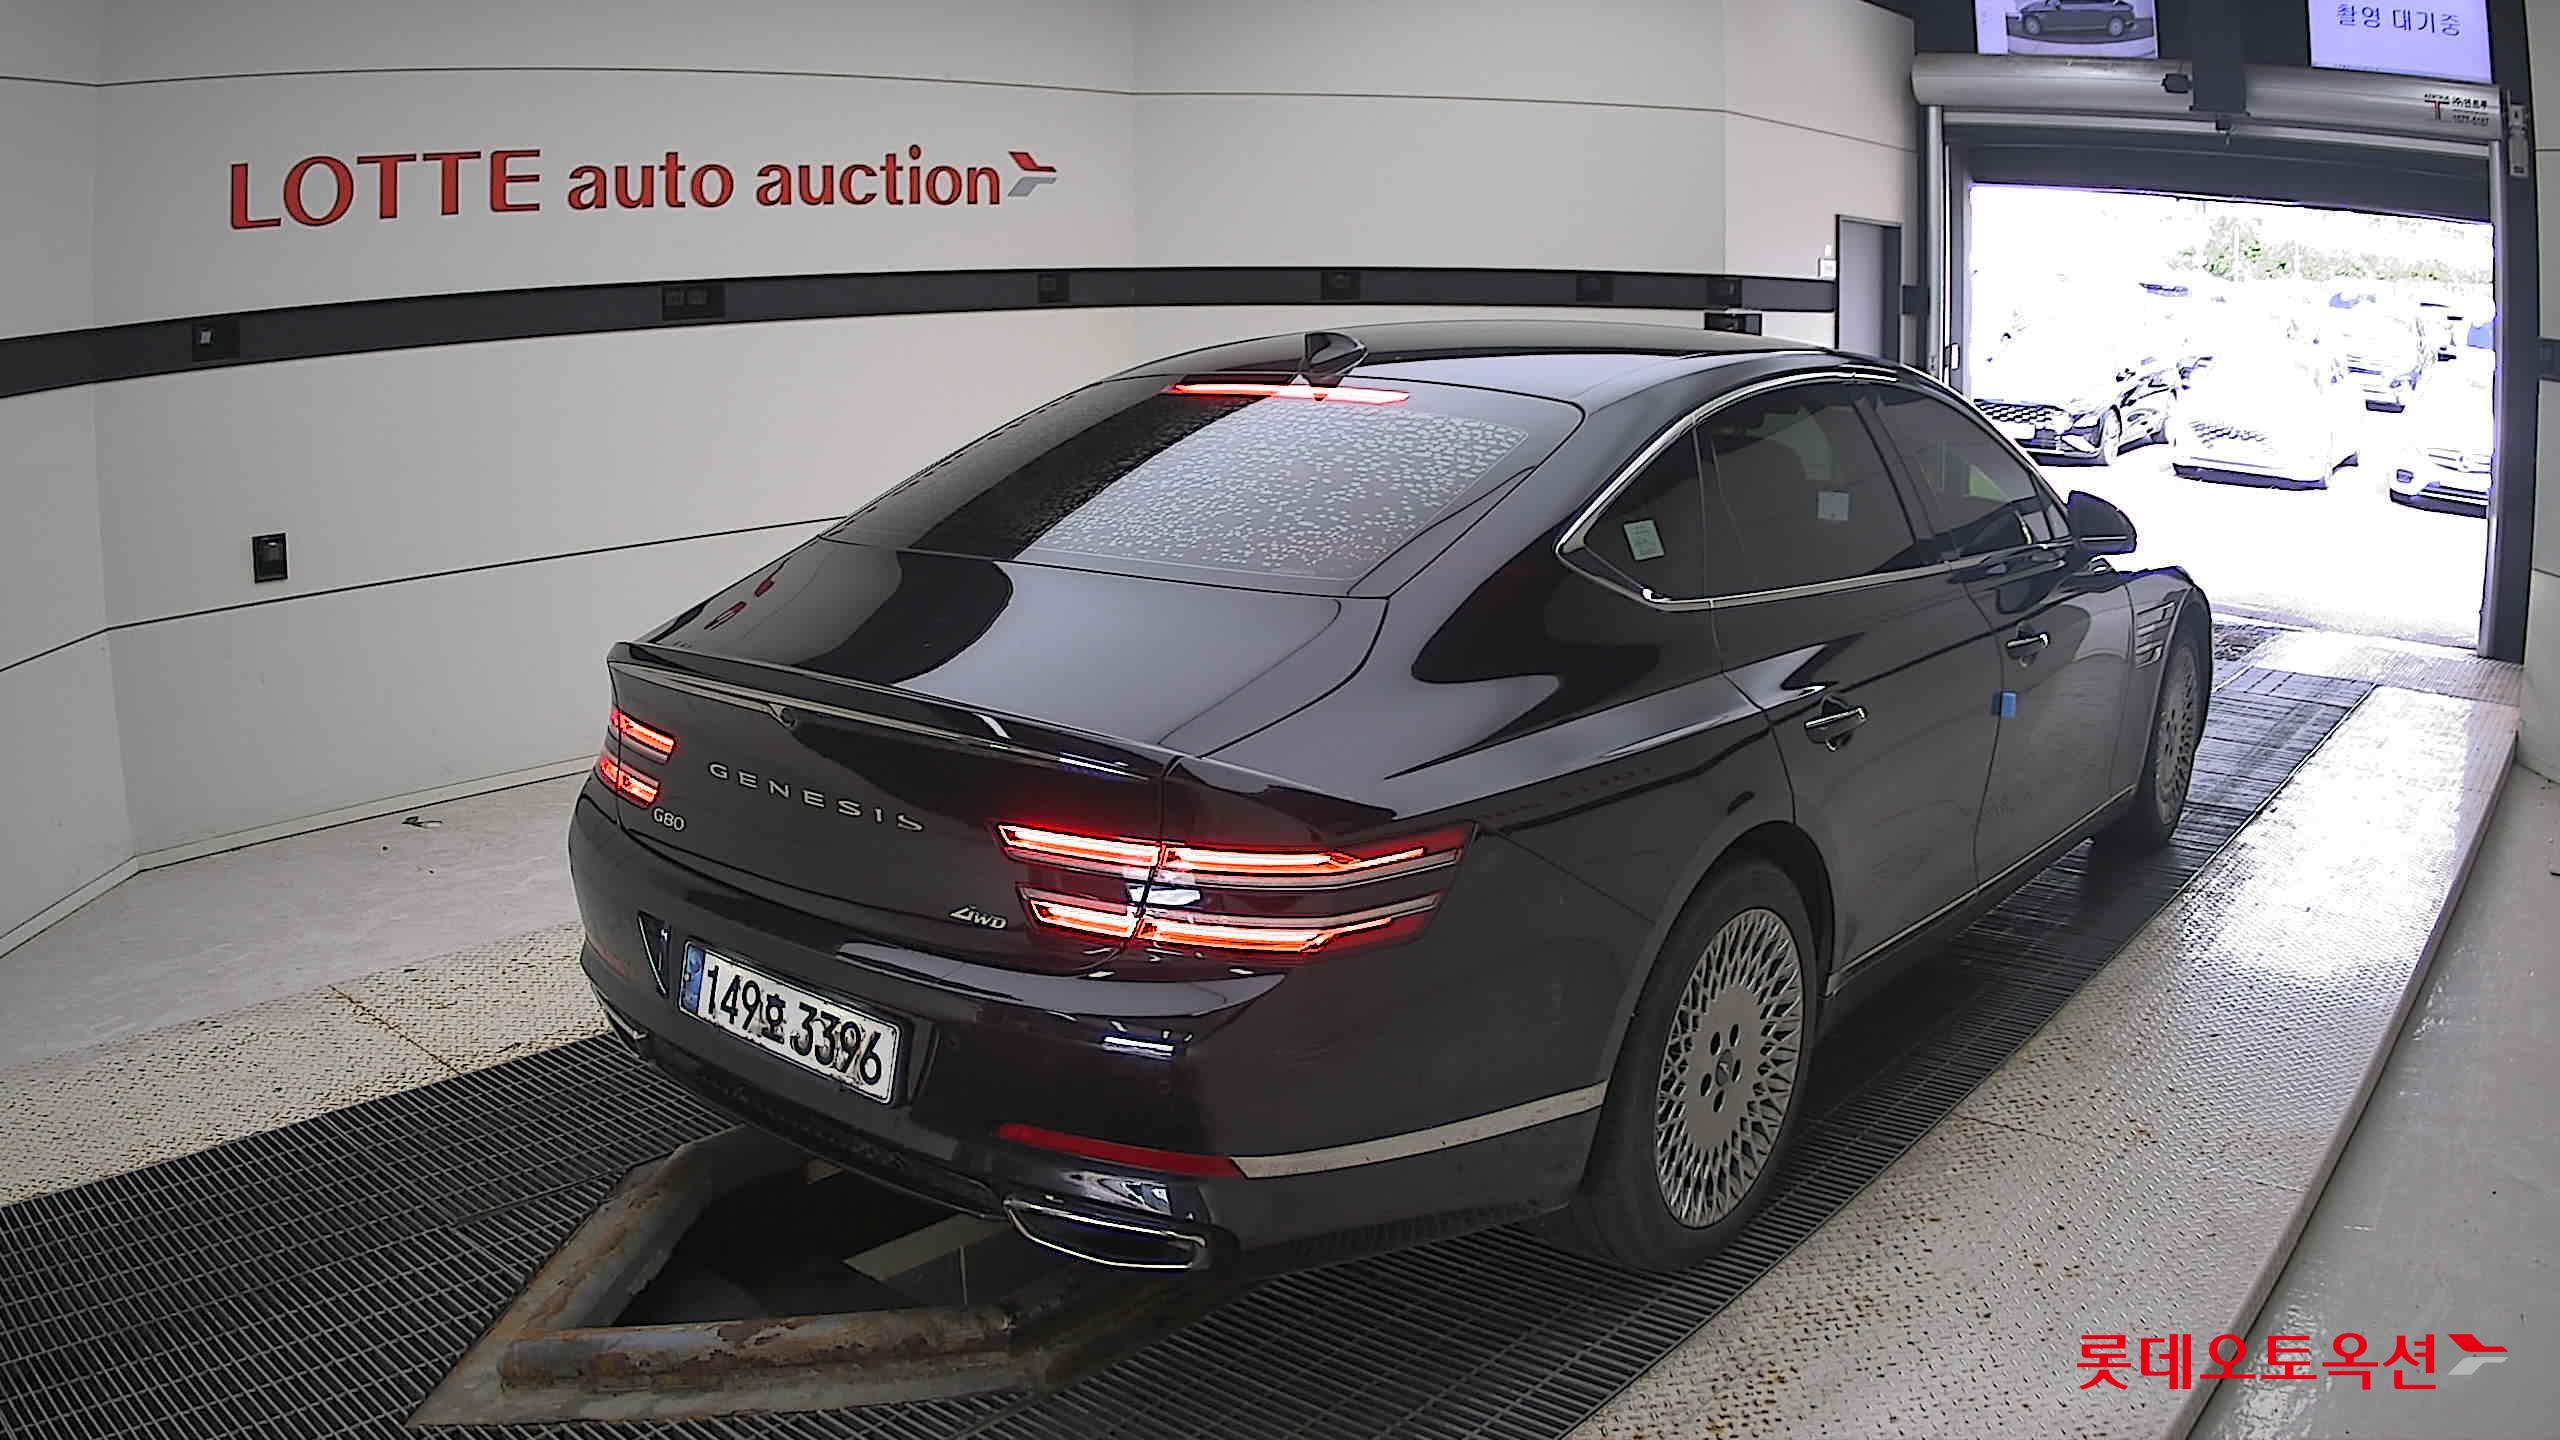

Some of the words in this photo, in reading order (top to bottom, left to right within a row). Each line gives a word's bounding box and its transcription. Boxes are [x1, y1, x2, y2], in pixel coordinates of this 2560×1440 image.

[2337, 3, 2382, 29] 촬영
[2392, 9, 2461, 37] 대기중
[229, 148, 542, 231] LOTTE
[566, 151, 736, 210] auto
[755, 144, 1001, 207] auction
[652, 807, 687, 832] G80
[708, 762, 924, 833] GENESIS
[707, 964, 788, 1045] 149호
[788, 1002, 883, 1086] 3396
